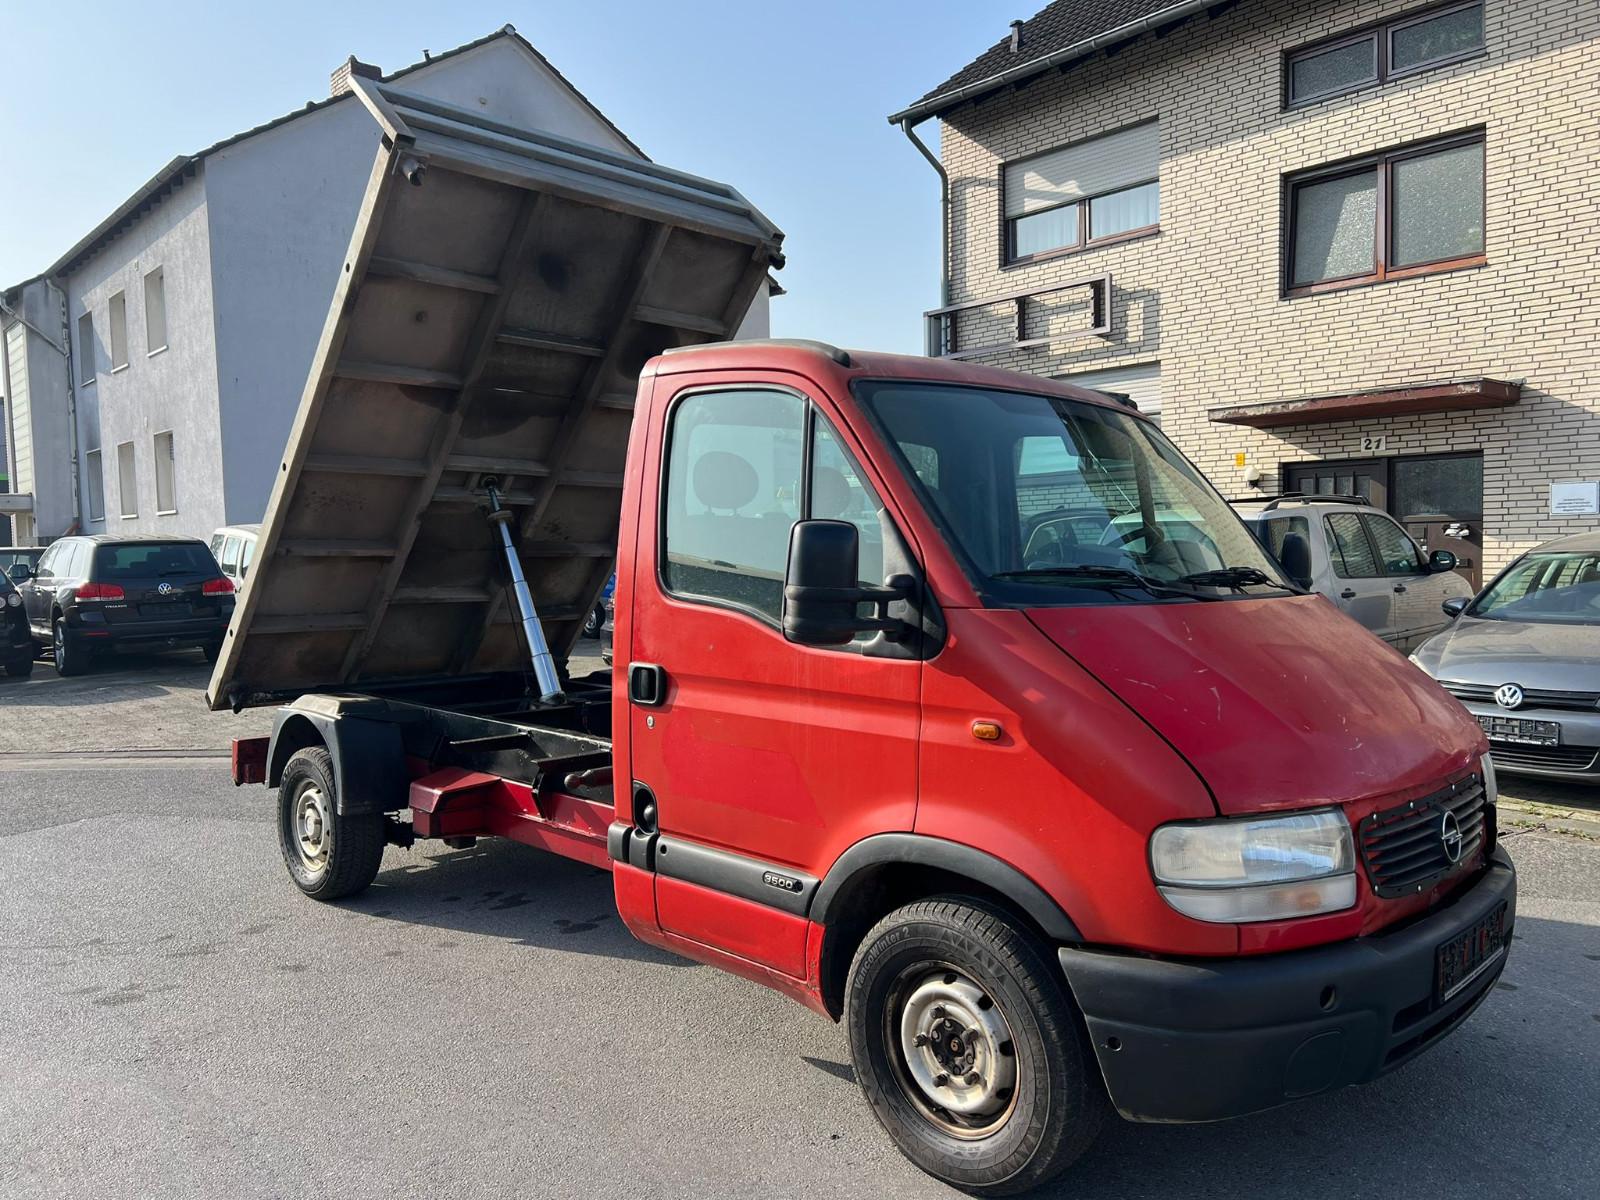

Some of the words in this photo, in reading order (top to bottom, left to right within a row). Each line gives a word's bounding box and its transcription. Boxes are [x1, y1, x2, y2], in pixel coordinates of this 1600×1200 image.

[1364, 438, 1381, 450] 21
[764, 874, 793, 889] 3500
[854, 932, 900, 989] VancoWinter
[902, 926, 910, 938] 2
